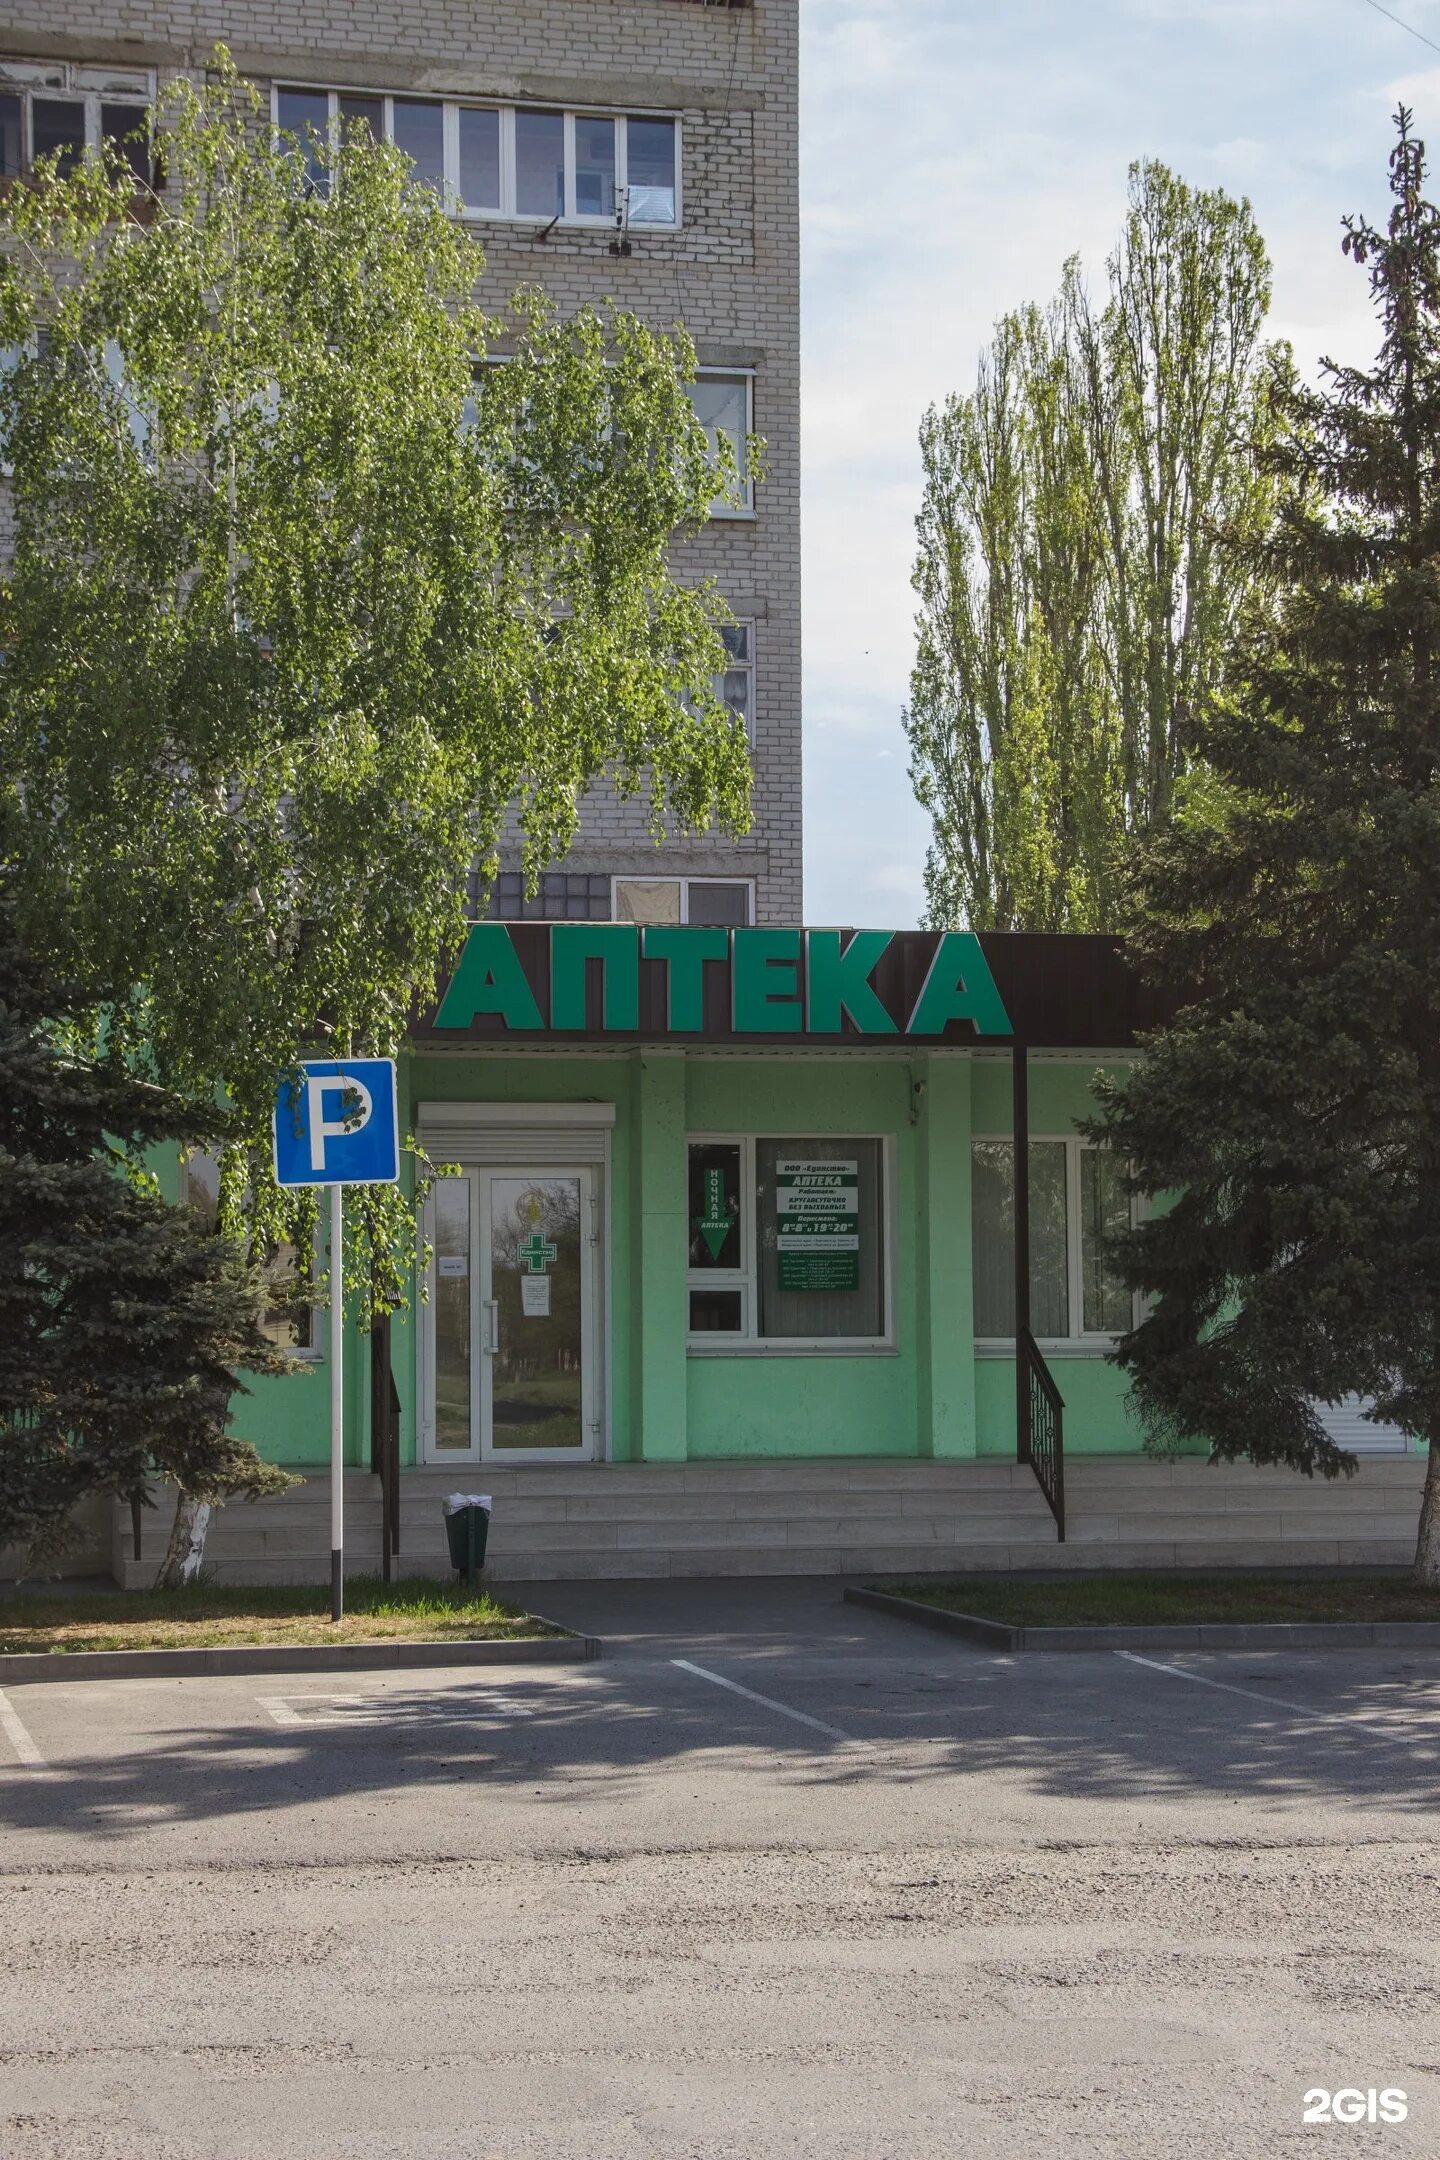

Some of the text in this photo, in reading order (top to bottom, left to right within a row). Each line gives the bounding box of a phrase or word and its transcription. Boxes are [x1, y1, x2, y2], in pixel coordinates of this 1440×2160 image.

[433, 924, 1013, 1035] АПТЕКА
[308, 1076, 373, 1170] P
[710, 1169, 718, 1220] НОЧНАЯ
[792, 1176, 842, 1186] АПТЕКА
